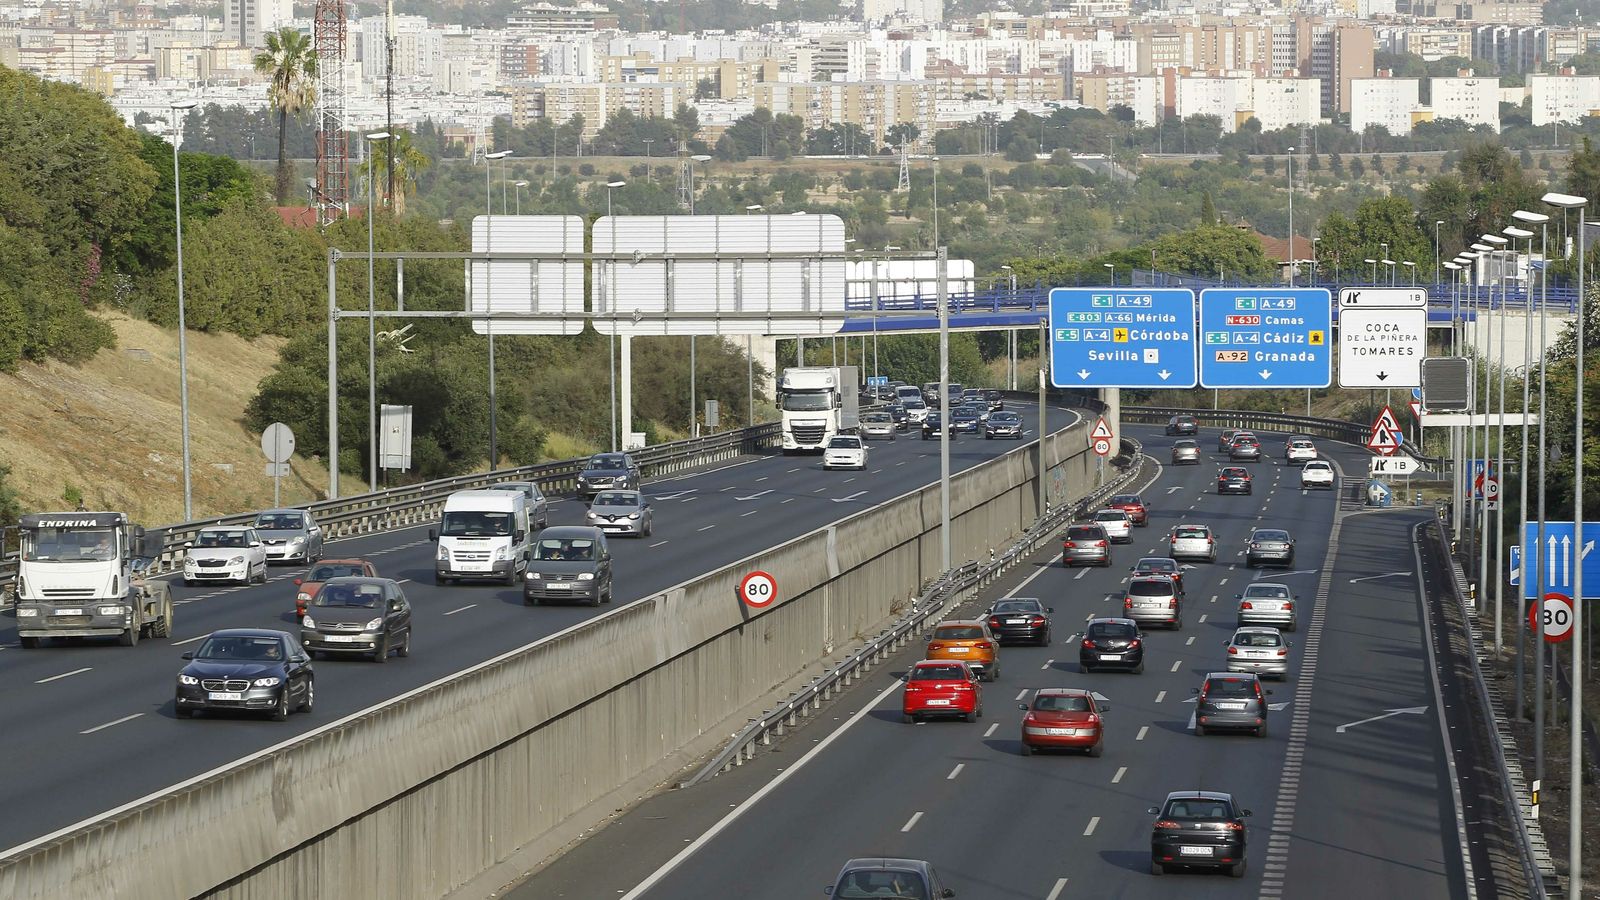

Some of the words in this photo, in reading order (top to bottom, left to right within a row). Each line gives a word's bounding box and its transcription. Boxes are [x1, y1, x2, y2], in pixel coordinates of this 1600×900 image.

[1237, 300, 1255, 308] E-1
[1262, 300, 1294, 308] A-49
[1136, 313, 1176, 322] Mérida
[1265, 316, 1304, 325] Camas
[1366, 324, 1400, 332] COCA
[1057, 331, 1078, 340] E-5
[1085, 331, 1108, 340] A-4
[1130, 330, 1189, 341] Córdoba
[1207, 333, 1228, 342] E-5
[1235, 333, 1258, 342] A-4
[1263, 333, 1304, 343] Cádiz
[1088, 350, 1138, 361] Sevilla
[1352, 347, 1413, 355] TOMARES
[1217, 352, 1247, 361] A-92
[1255, 351, 1315, 361] Granada
[1394, 461, 1406, 470] 1B
[38, 519, 97, 527] ENDRINA
[748, 583, 769, 595] 80
[1543, 609, 1568, 625] 80
